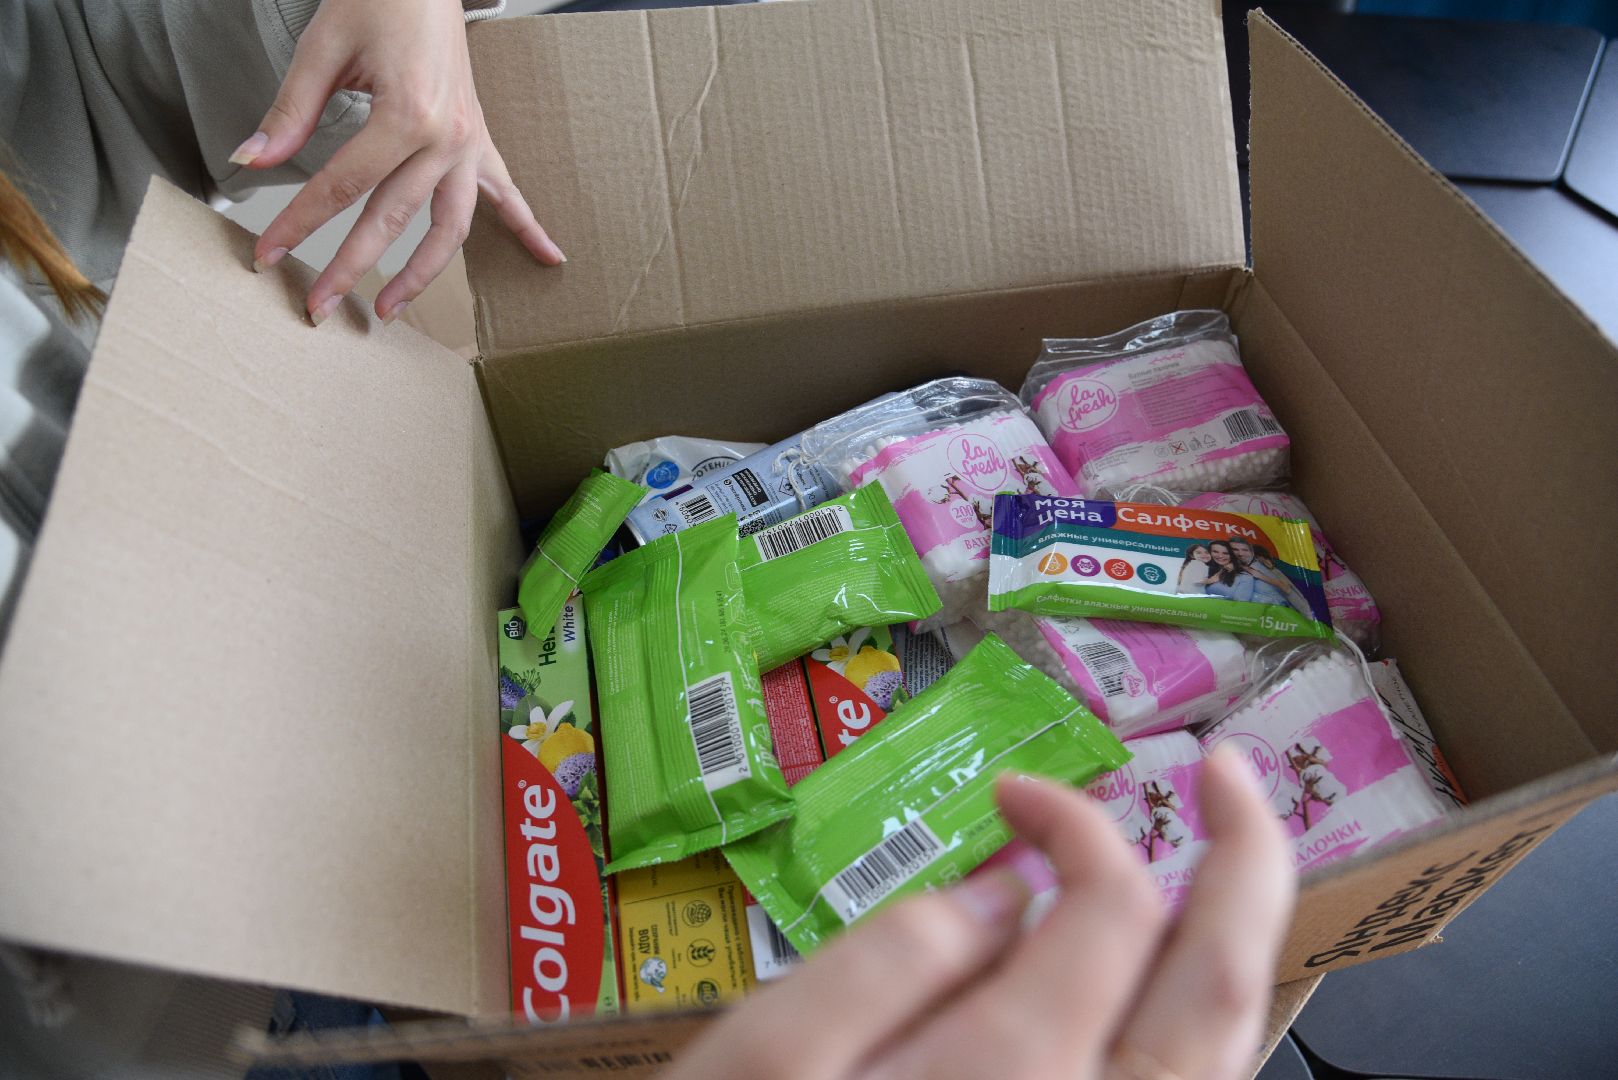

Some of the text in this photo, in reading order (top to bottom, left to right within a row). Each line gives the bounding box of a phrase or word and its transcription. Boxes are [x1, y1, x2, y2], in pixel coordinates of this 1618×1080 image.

[1067, 388, 1116, 430] fresh
[1071, 385, 1095, 405] la
[961, 439, 987, 461] la
[961, 447, 1005, 482] fresh
[952, 505, 974, 519] 200
[1117, 507, 1258, 540] Салфетки
[1038, 531, 1180, 554] влажные универсальные
[563, 605, 577, 643] White
[1036, 595, 1084, 606] Салфетки
[1083, 600, 1130, 611] влажные
[1131, 604, 1208, 620] универсальные
[1086, 768, 1136, 802] resh
[520, 784, 577, 1025] Colgate
[1366, 823, 1553, 953] Маркет
[1303, 850, 1479, 968] Яндекс
[637, 928, 651, 956] ВОДУ
